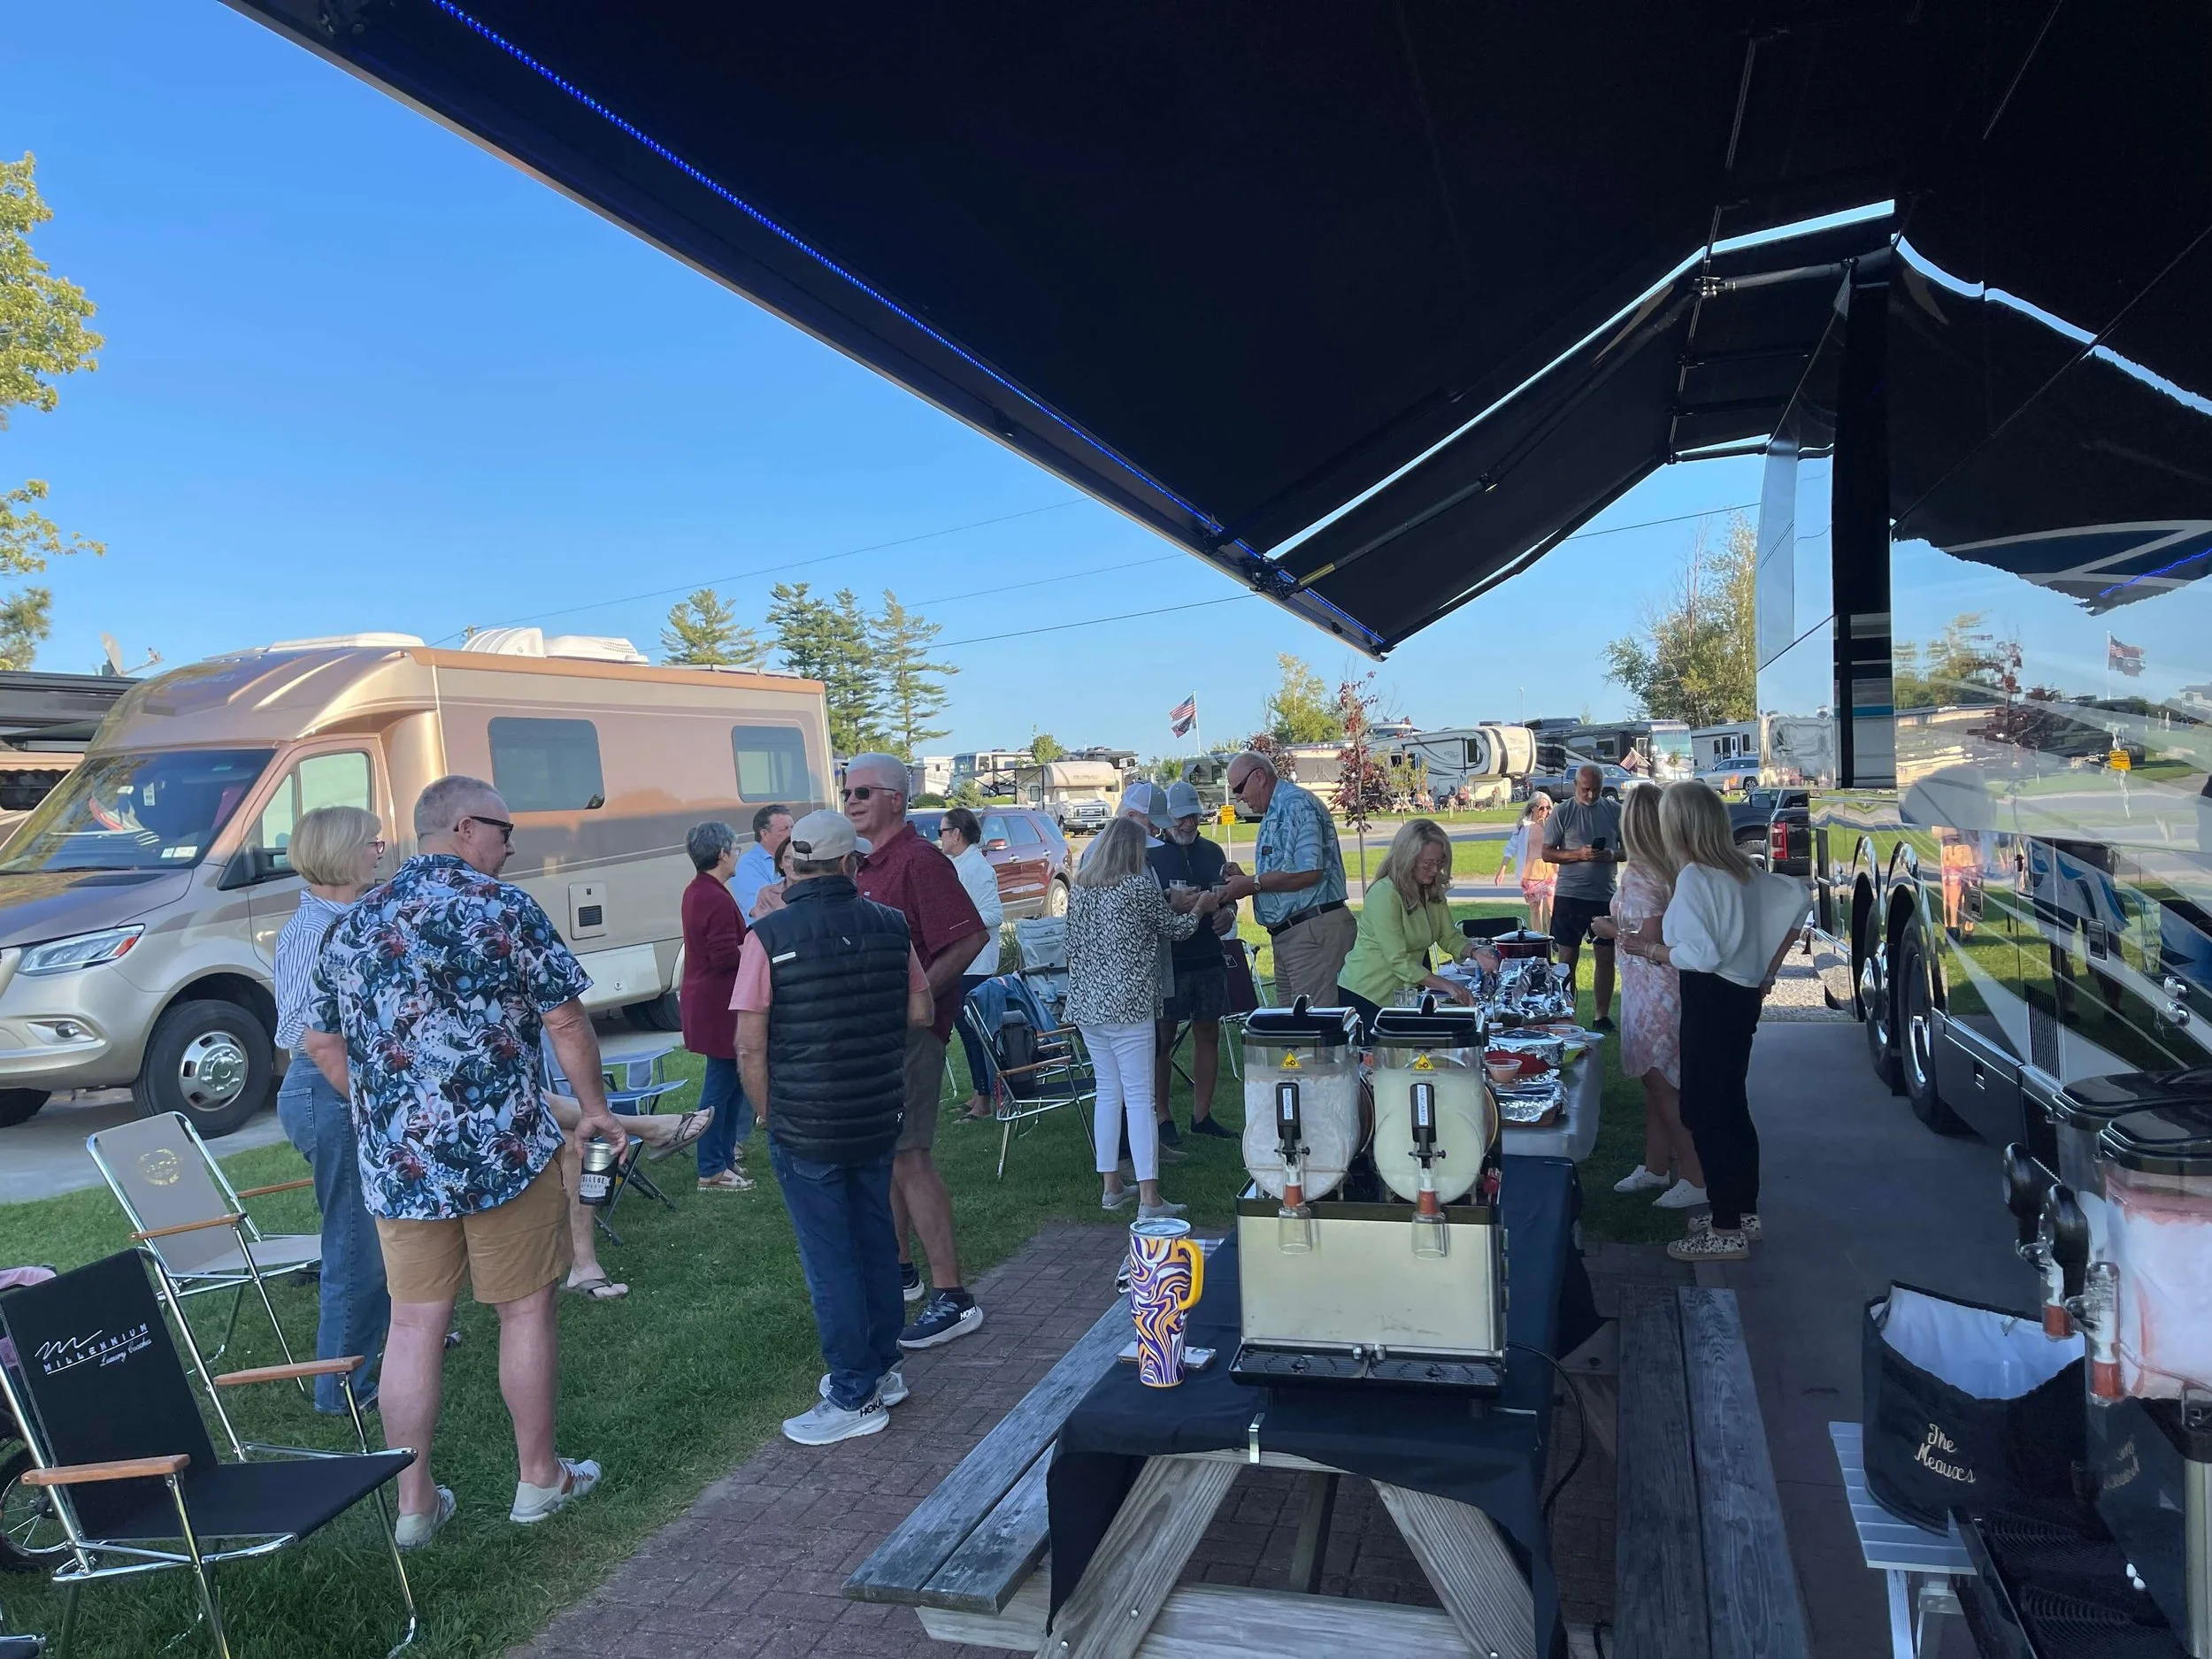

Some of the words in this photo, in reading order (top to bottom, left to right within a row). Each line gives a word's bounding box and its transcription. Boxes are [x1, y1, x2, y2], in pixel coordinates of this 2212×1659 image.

[960, 1306, 977, 1320] HOKA
[43, 1323, 148, 1373] MILLENNIUM
[859, 1398, 884, 1417] HOKA
[1928, 1423, 1957, 1453] The
